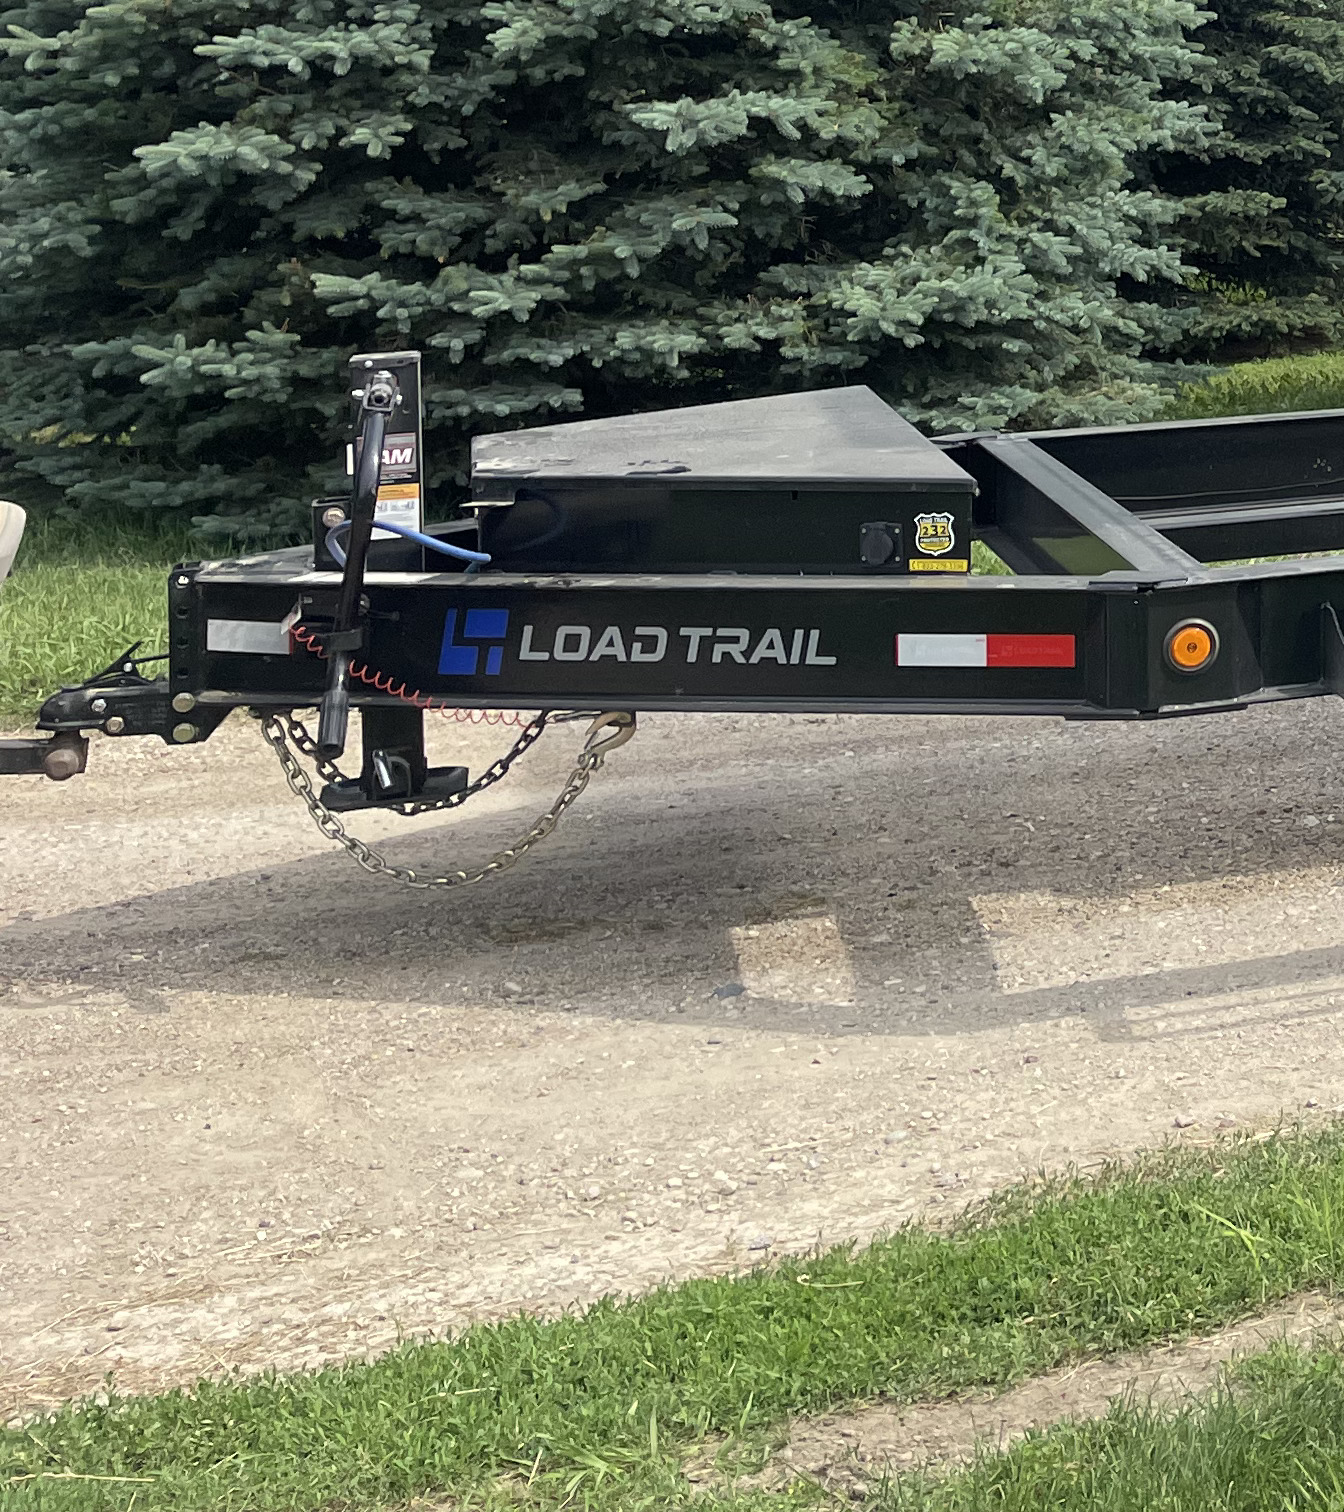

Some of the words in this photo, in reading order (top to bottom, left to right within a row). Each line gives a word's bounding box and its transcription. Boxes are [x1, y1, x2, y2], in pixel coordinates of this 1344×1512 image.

[922, 525, 946, 537] 232
[519, 624, 668, 663] LOAD
[679, 626, 837, 666] TRAIL
